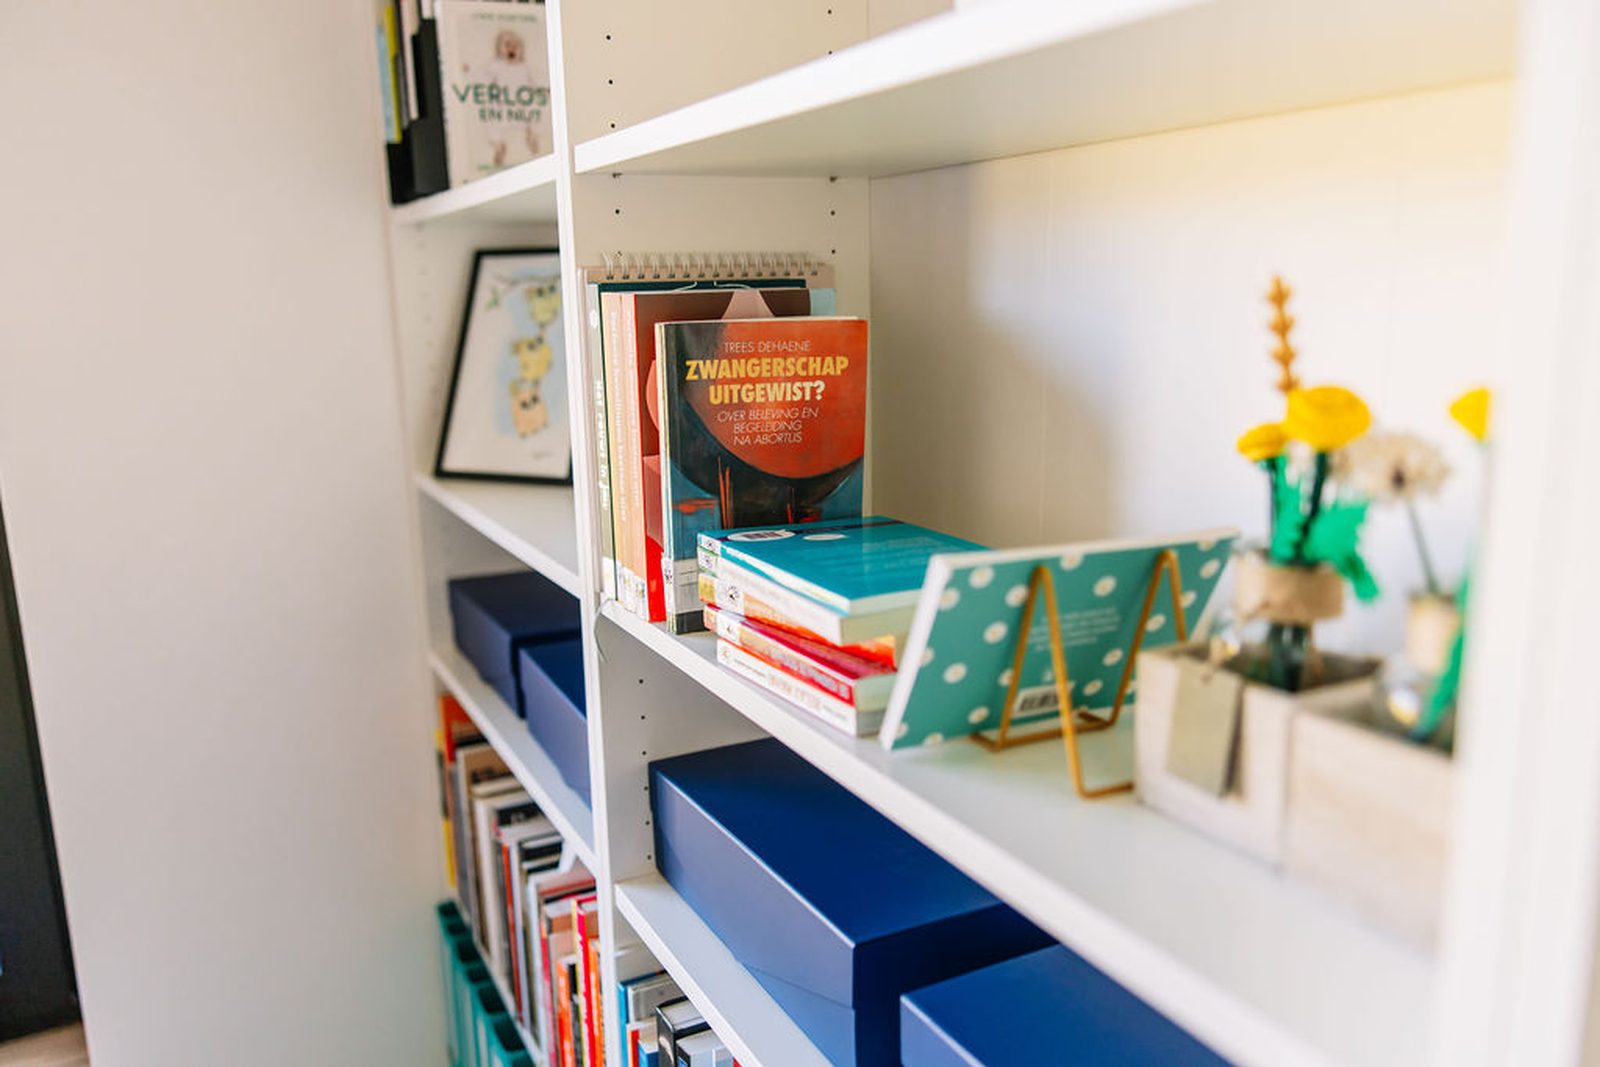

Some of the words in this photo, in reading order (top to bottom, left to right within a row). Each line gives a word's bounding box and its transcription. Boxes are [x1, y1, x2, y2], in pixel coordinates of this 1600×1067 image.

[452, 83, 551, 106] VERLOS
[724, 341, 754, 353] TREES
[758, 340, 812, 352] DEHAENE
[685, 356, 849, 381] ZWANGERSCHAP
[709, 380, 826, 405] UITGEWIST?
[717, 410, 747, 422] OVER
[749, 408, 800, 420] BELEVING
[801, 407, 820, 418] EN
[733, 419, 803, 433] BEGELEIDING
[733, 435, 752, 446] NA
[753, 432, 803, 445] ABORTUS
